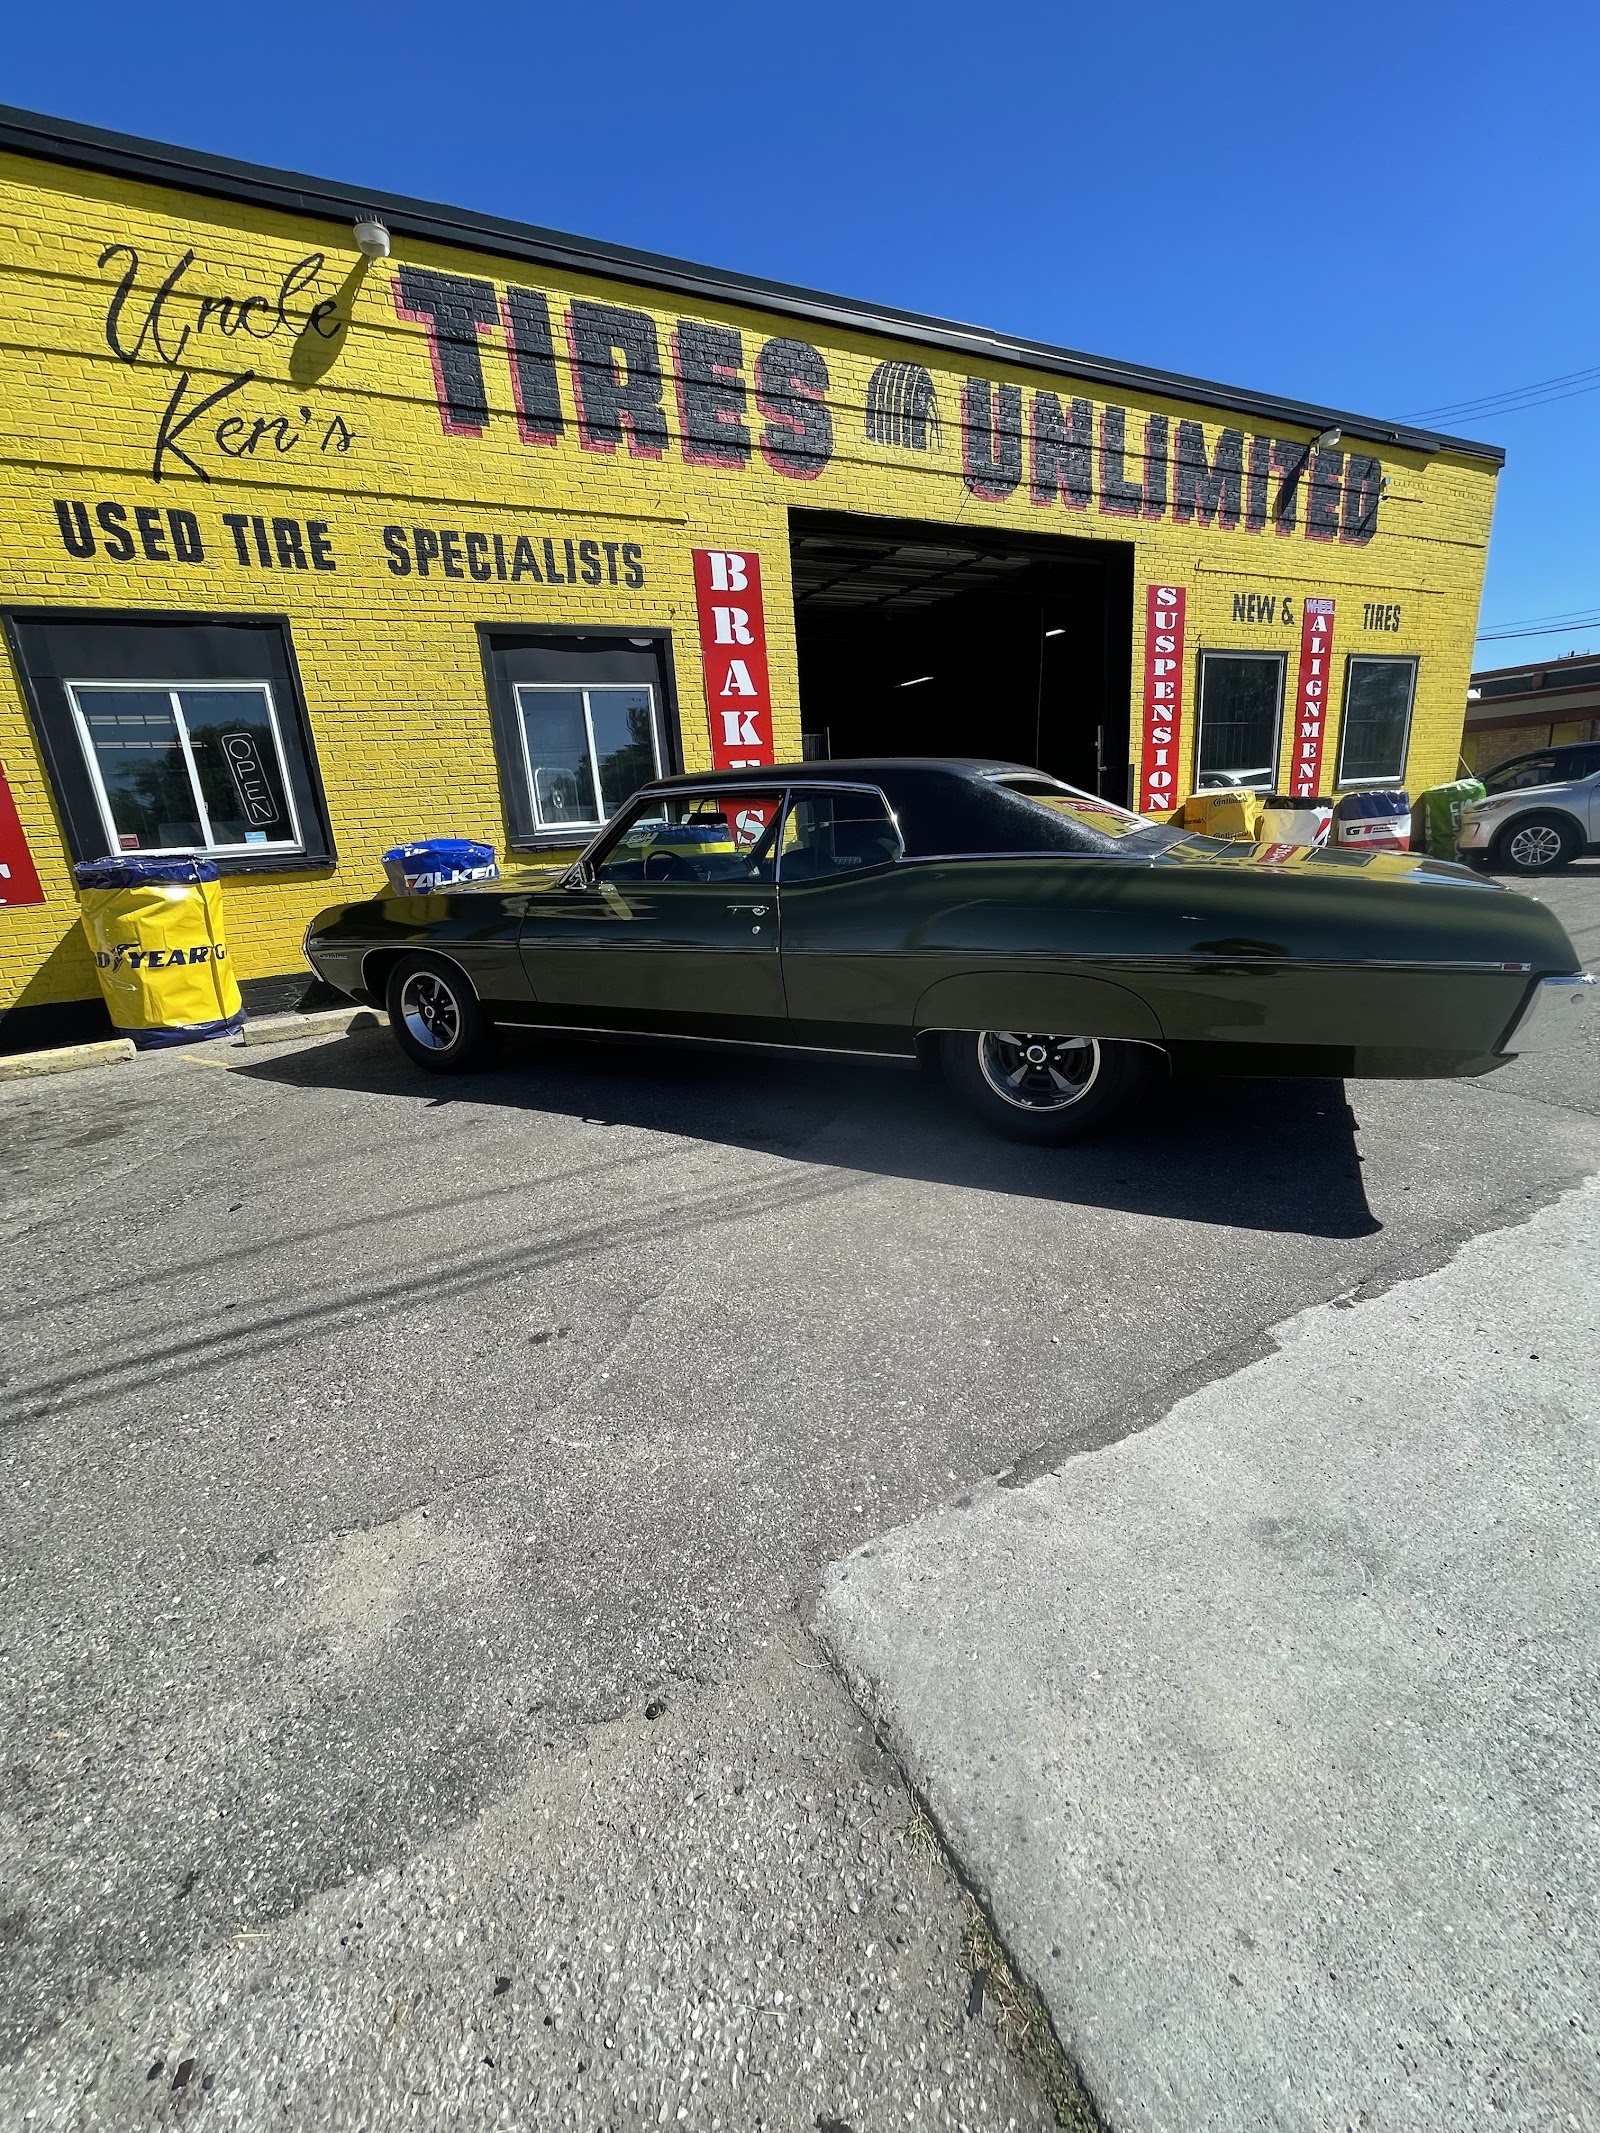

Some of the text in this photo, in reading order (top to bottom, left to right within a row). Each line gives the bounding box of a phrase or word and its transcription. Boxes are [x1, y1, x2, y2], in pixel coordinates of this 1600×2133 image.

[98, 244, 343, 364] Uncle
[152, 369, 354, 484] Ken's
[391, 264, 836, 481] TIRES
[962, 375, 1381, 546] UNLIMITED
[54, 499, 645, 589] USED TIRE SPECIALISTS
[1233, 593, 1401, 633] NEW & TIRES
[1306, 599, 1335, 614] WHEEL
[707, 551, 766, 845] BRAKS
[1146, 587, 1177, 811] SUSPENSION
[1297, 615, 1328, 798] ALIGNMENT
[229, 738, 273, 819] OPEN
[1346, 823, 1375, 836] GT
